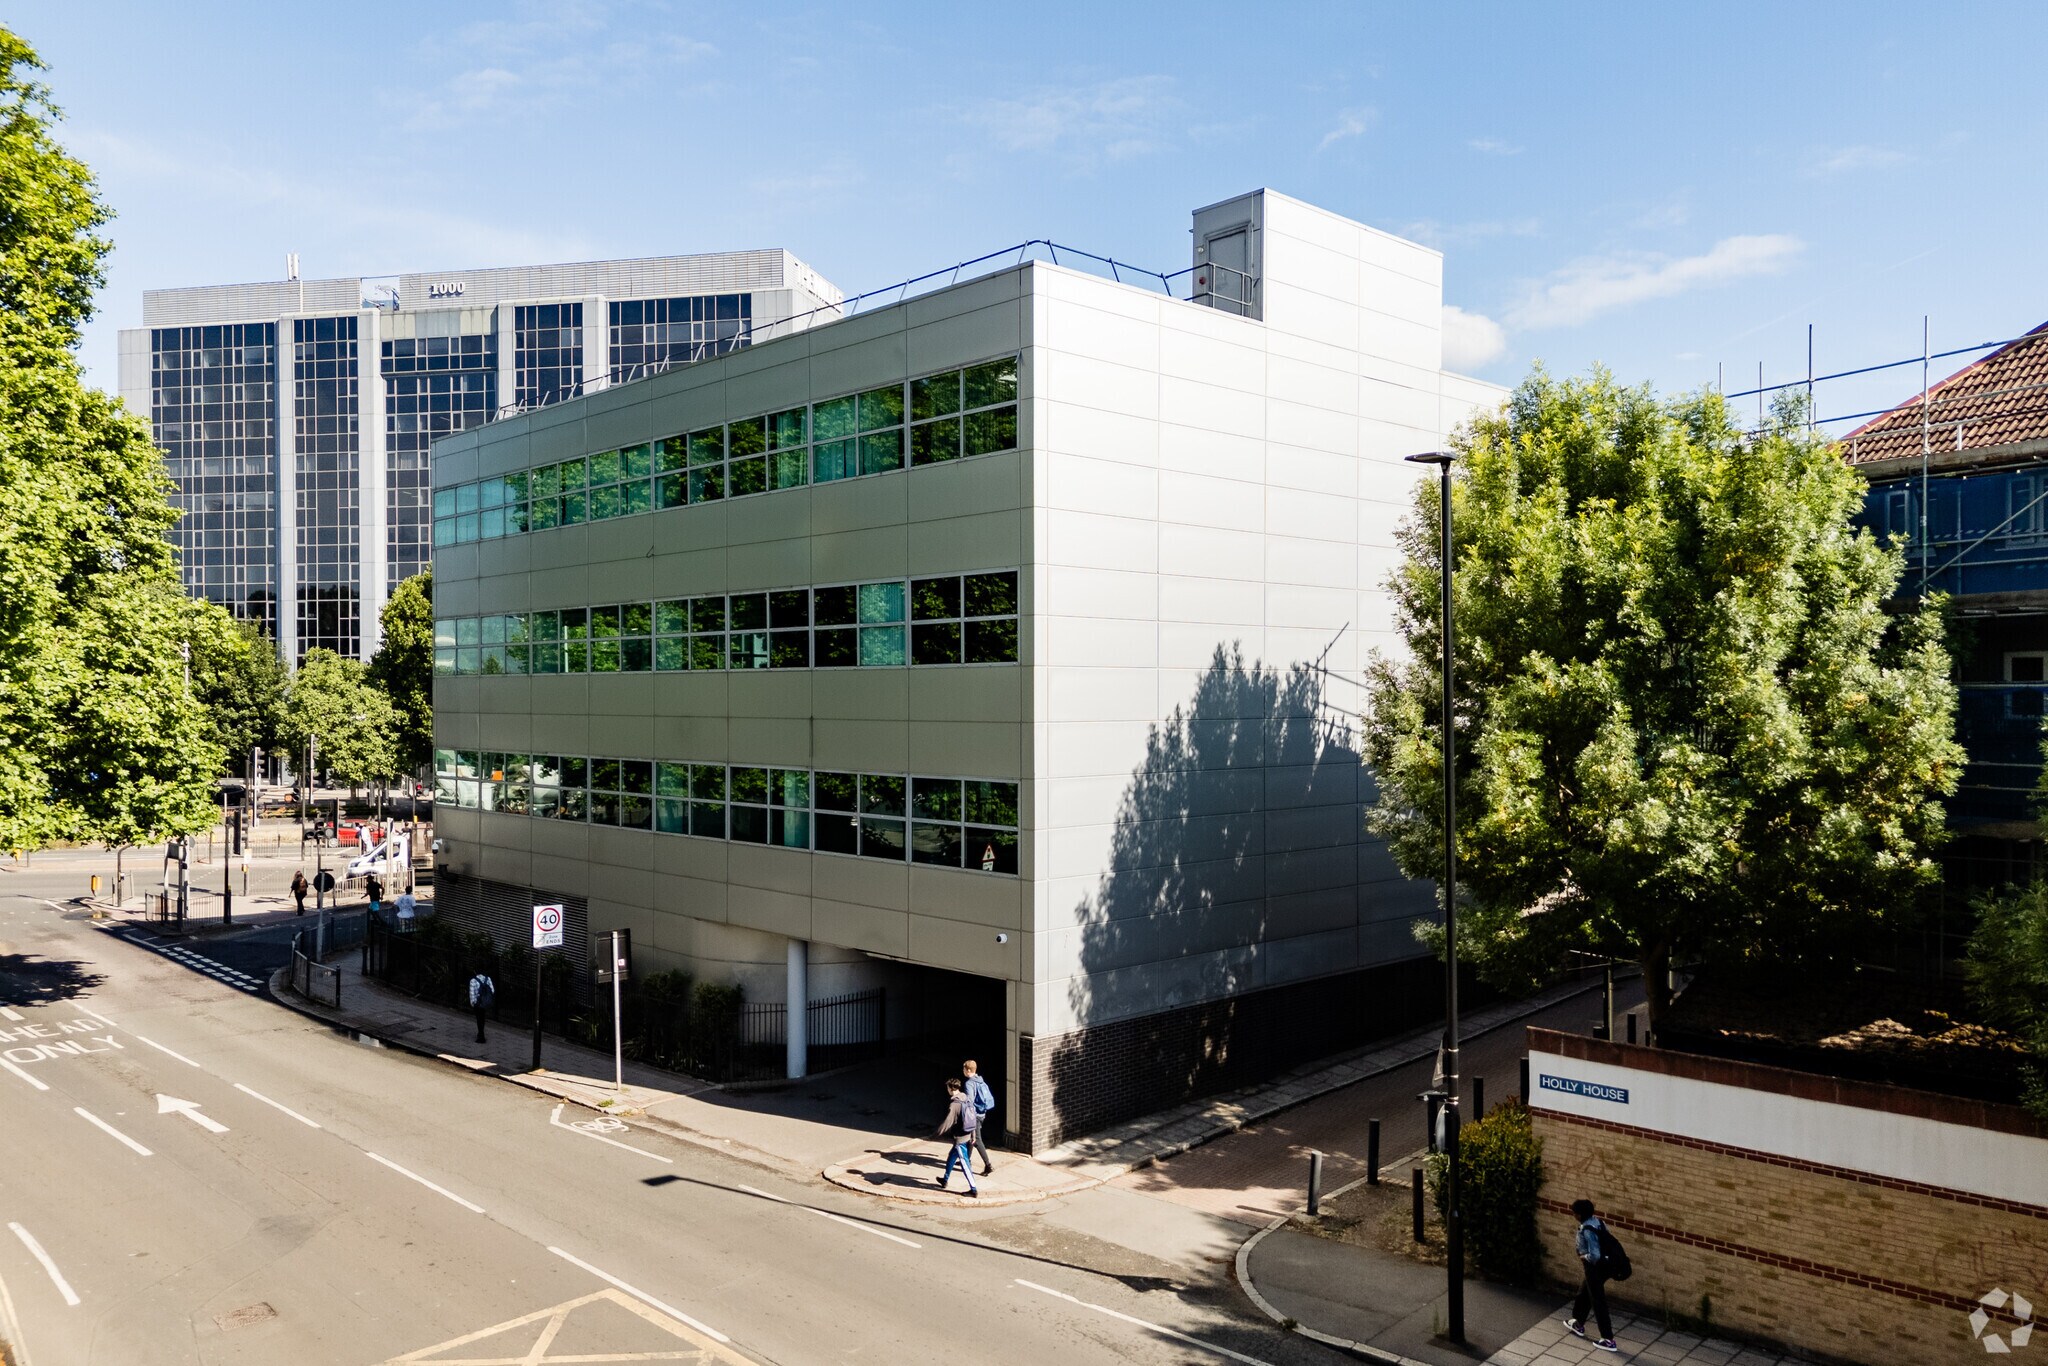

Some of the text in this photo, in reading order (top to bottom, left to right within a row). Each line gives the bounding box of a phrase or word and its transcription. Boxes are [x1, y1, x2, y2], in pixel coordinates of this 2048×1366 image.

[430, 281, 466, 296] 1000
[540, 914, 557, 925] 40
[0, 1019, 104, 1042] HEAD
[2, 1035, 125, 1063] ONLY
[1542, 1076, 1625, 1101] HOLLY HOUSE
